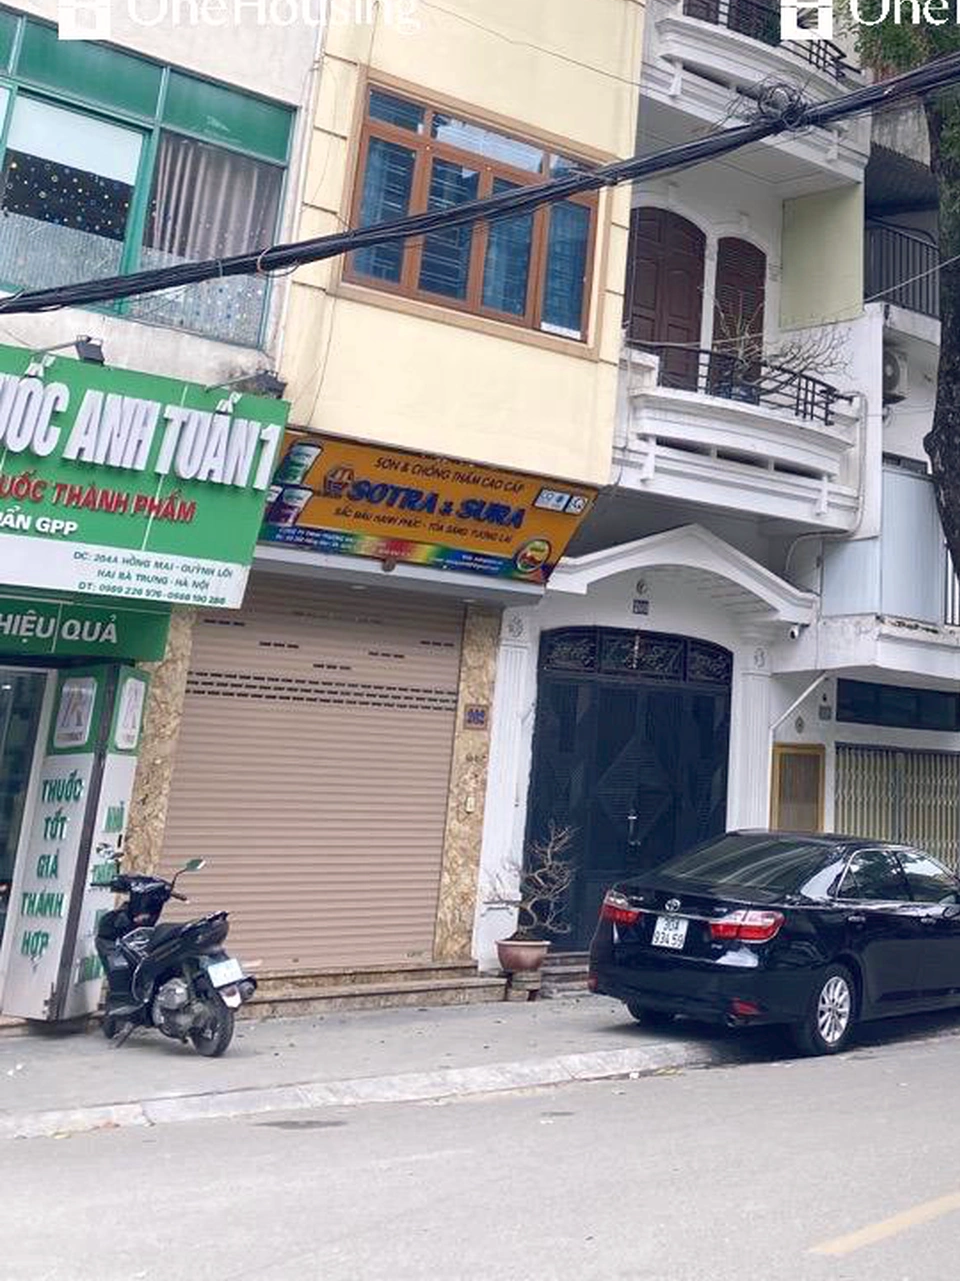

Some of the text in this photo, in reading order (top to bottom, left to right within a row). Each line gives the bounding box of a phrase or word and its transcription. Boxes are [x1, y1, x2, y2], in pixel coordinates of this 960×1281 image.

[61, 389, 161, 472] ANH
[154, 391, 261, 488] TUẤN
[252, 423, 281, 491] 1
[35, 516, 78, 536] GPP
[0, 609, 118, 643] HIỆU QUẢ
[42, 771, 83, 803] THUỐC
[44, 806, 68, 840] TỐT
